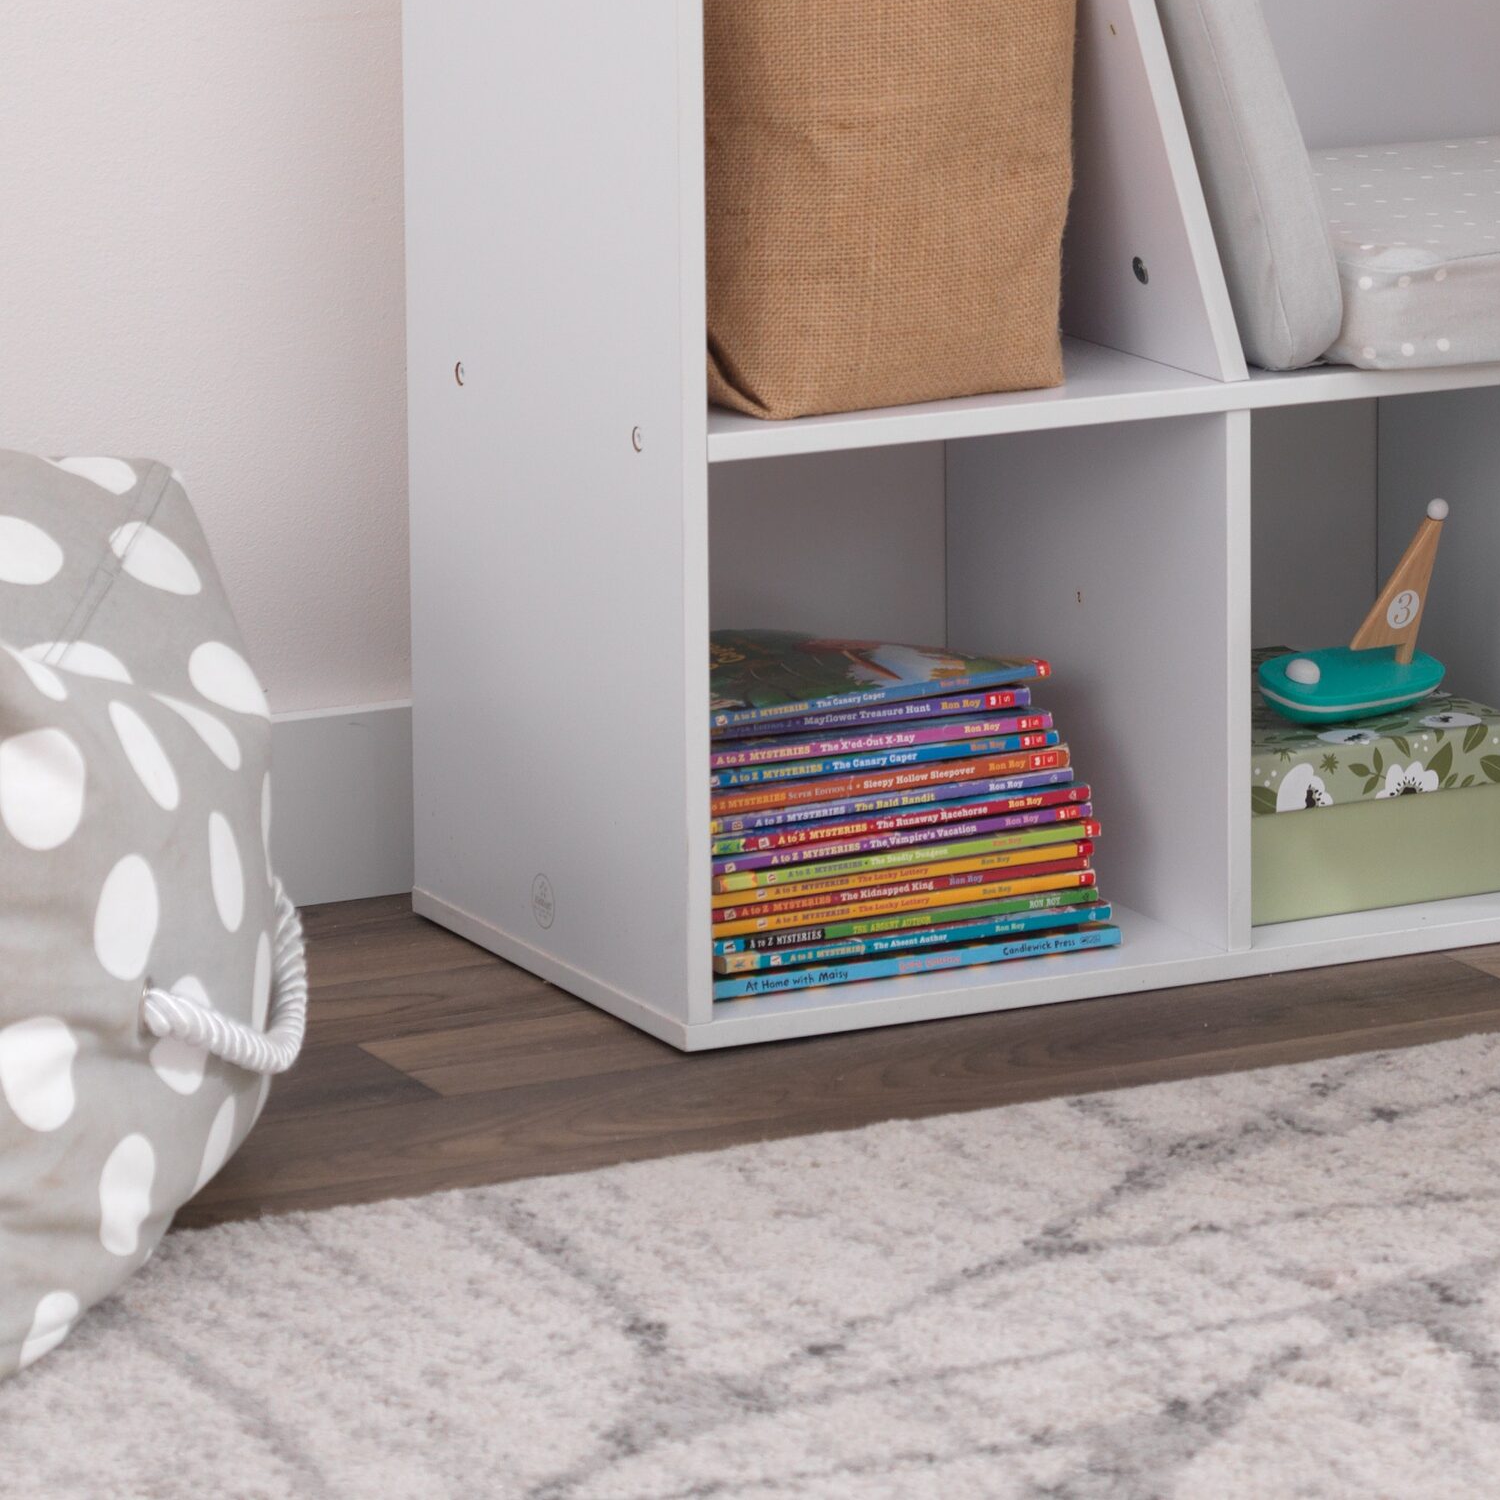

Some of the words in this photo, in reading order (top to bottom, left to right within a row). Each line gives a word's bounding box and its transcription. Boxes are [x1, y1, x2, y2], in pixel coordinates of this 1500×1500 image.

[1394, 594, 1414, 626] 3
[804, 712, 857, 725] Mayflower
[859, 706, 904, 719] Treasure
[906, 704, 931, 714] Hunt
[941, 702, 960, 710] Ron
[962, 699, 981, 710] Roy
[816, 700, 831, 708] The
[750, 746, 810, 761] MYSTERIES
[820, 744, 839, 753] The
[886, 734, 916, 745] X-Ray
[964, 726, 981, 734] Ron
[983, 723, 1000, 732] Roy
[762, 764, 823, 779] MYSTERIES
[832, 762, 851, 770] The
[853, 756, 888, 768] Canary
[889, 753, 918, 763] Caper
[864, 778, 894, 790] Sleepy
[896, 772, 928, 784] Hollow
[930, 766, 976, 780] Sleepover
[989, 762, 1007, 772] Ron
[1008, 760, 1026, 771] Roy
[787, 806, 846, 822] MYSTERIES
[855, 802, 874, 812] The
[876, 798, 899, 809] Bald
[902, 794, 936, 806] Bandit
[989, 782, 1006, 791] Ron
[1007, 780, 1024, 789] Roy
[810, 823, 868, 840] MYSTERIES
[876, 820, 894, 830] The
[896, 813, 939, 828] Runaway
[940, 806, 988, 821] Racehorse
[1008, 800, 1025, 809] Ron
[1026, 797, 1043, 806] Roy
[803, 843, 861, 859] MYSTERIES
[870, 838, 889, 849] The
[889, 830, 936, 845] Vampire's
[938, 824, 977, 837] Vacation
[1005, 819, 1022, 827] Ron
[1023, 815, 1040, 824] Roy
[841, 891, 858, 902] The
[860, 885, 910, 899] Kidnapped
[912, 881, 934, 891] King
[776, 930, 822, 945] MYSTERIES
[874, 942, 889, 950] The
[890, 938, 918, 948] Absent
[920, 934, 948, 944] Author
[746, 981, 758, 992] At
[762, 978, 789, 990] Home
[793, 973, 815, 985] with
[819, 970, 848, 982] Maisy
[1003, 942, 1052, 956] Candlewick
[1055, 940, 1076, 949] Press
